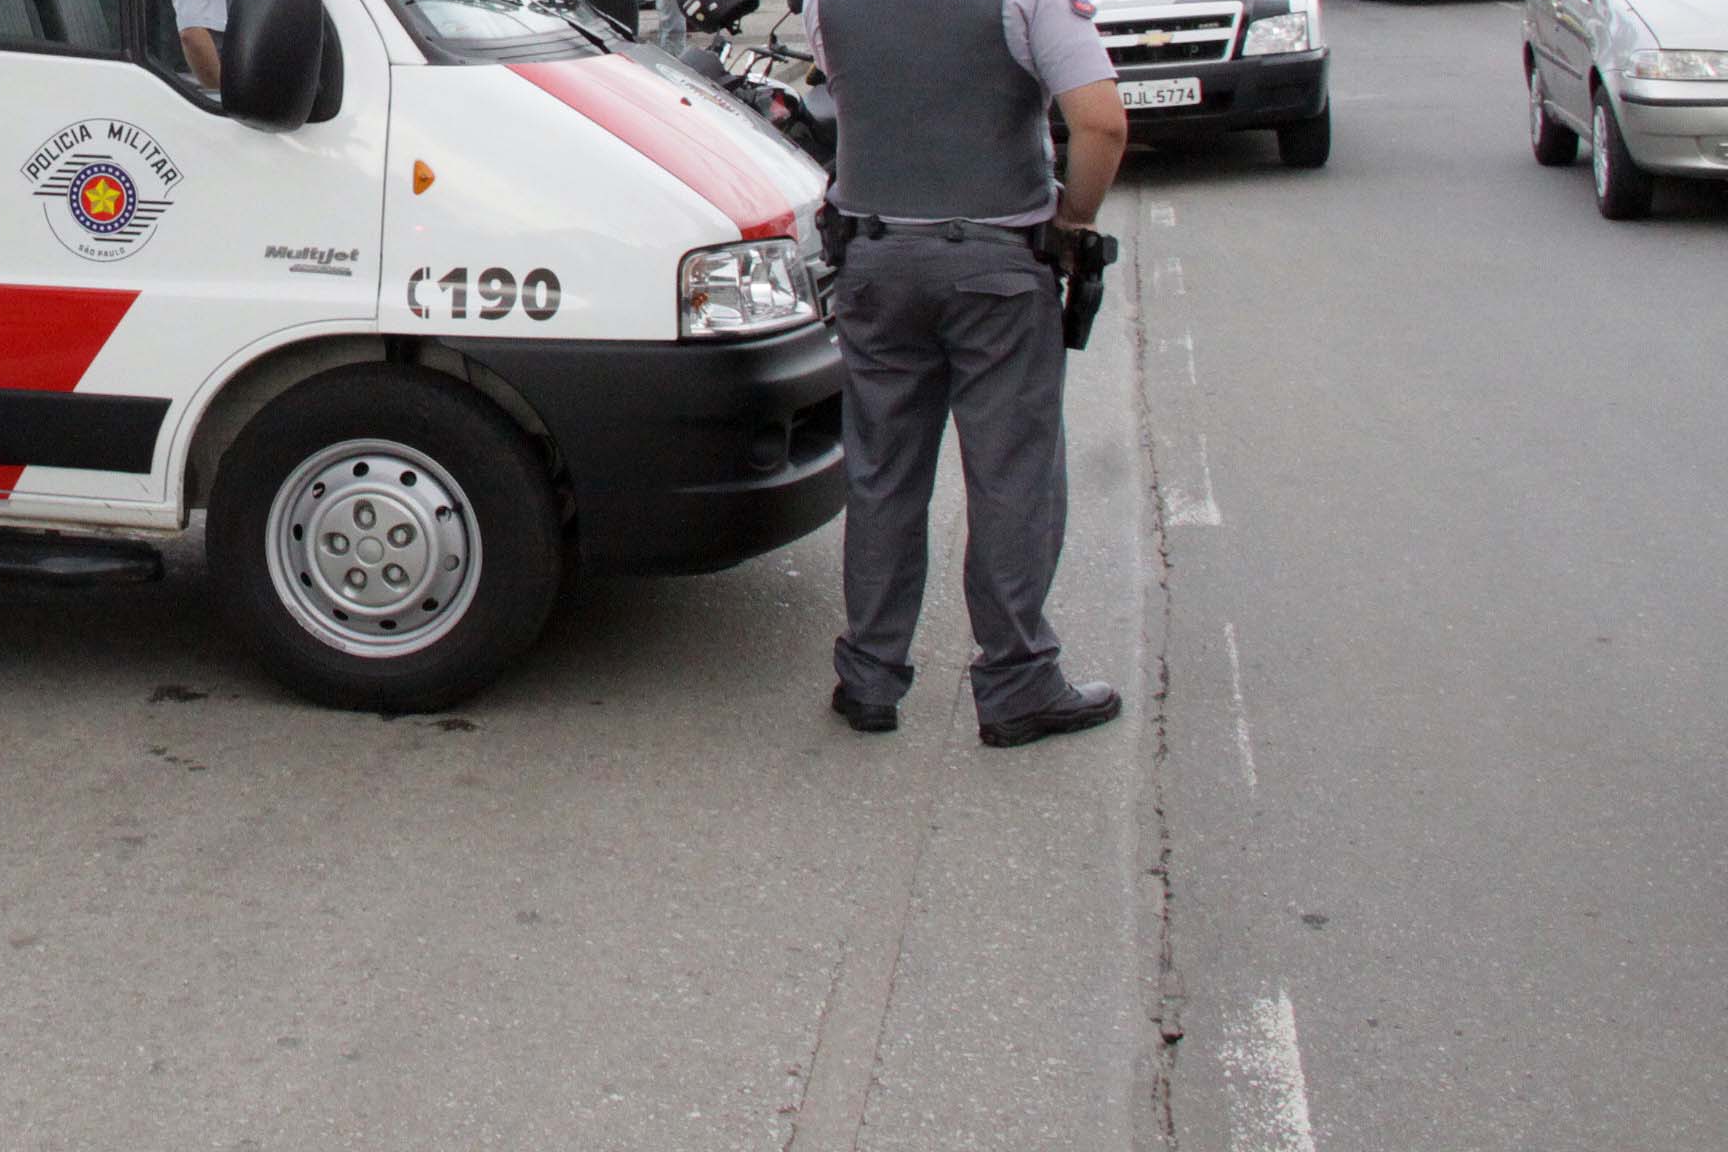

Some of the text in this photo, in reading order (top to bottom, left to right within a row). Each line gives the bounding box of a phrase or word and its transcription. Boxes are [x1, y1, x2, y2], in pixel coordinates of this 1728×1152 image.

[26, 122, 177, 185] POLICIA MILITAR
[437, 267, 561, 321] 190
